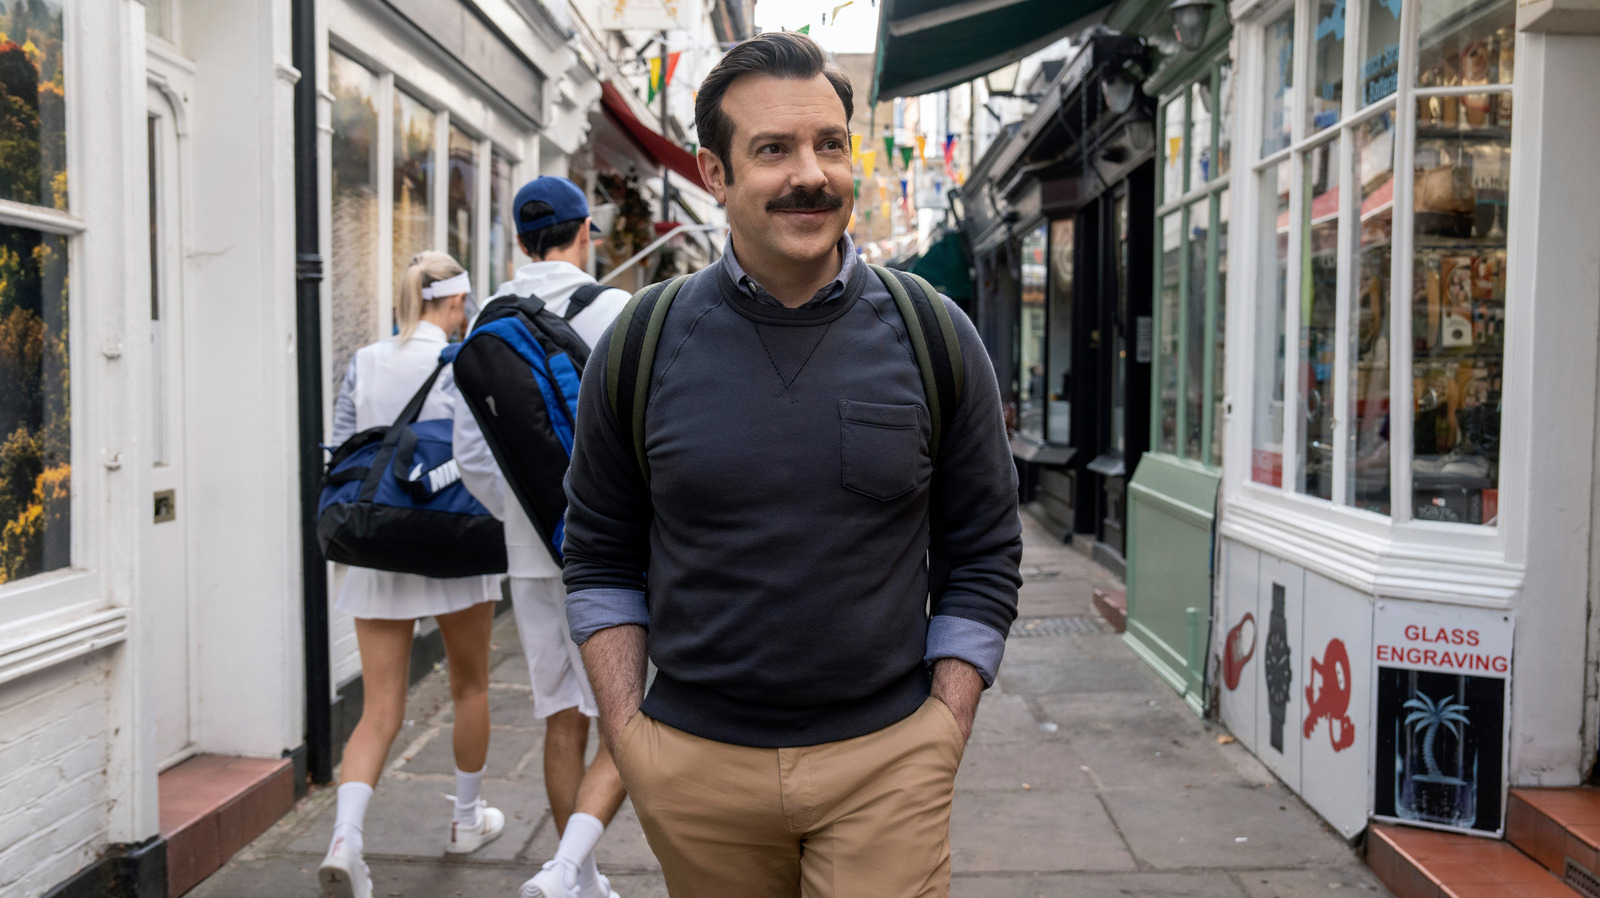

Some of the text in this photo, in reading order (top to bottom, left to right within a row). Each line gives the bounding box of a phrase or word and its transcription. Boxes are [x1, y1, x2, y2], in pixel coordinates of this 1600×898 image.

[428, 458, 461, 493] NIK
[1404, 624, 1480, 647] GLASS
[1376, 644, 1508, 673] ENGRAVING
